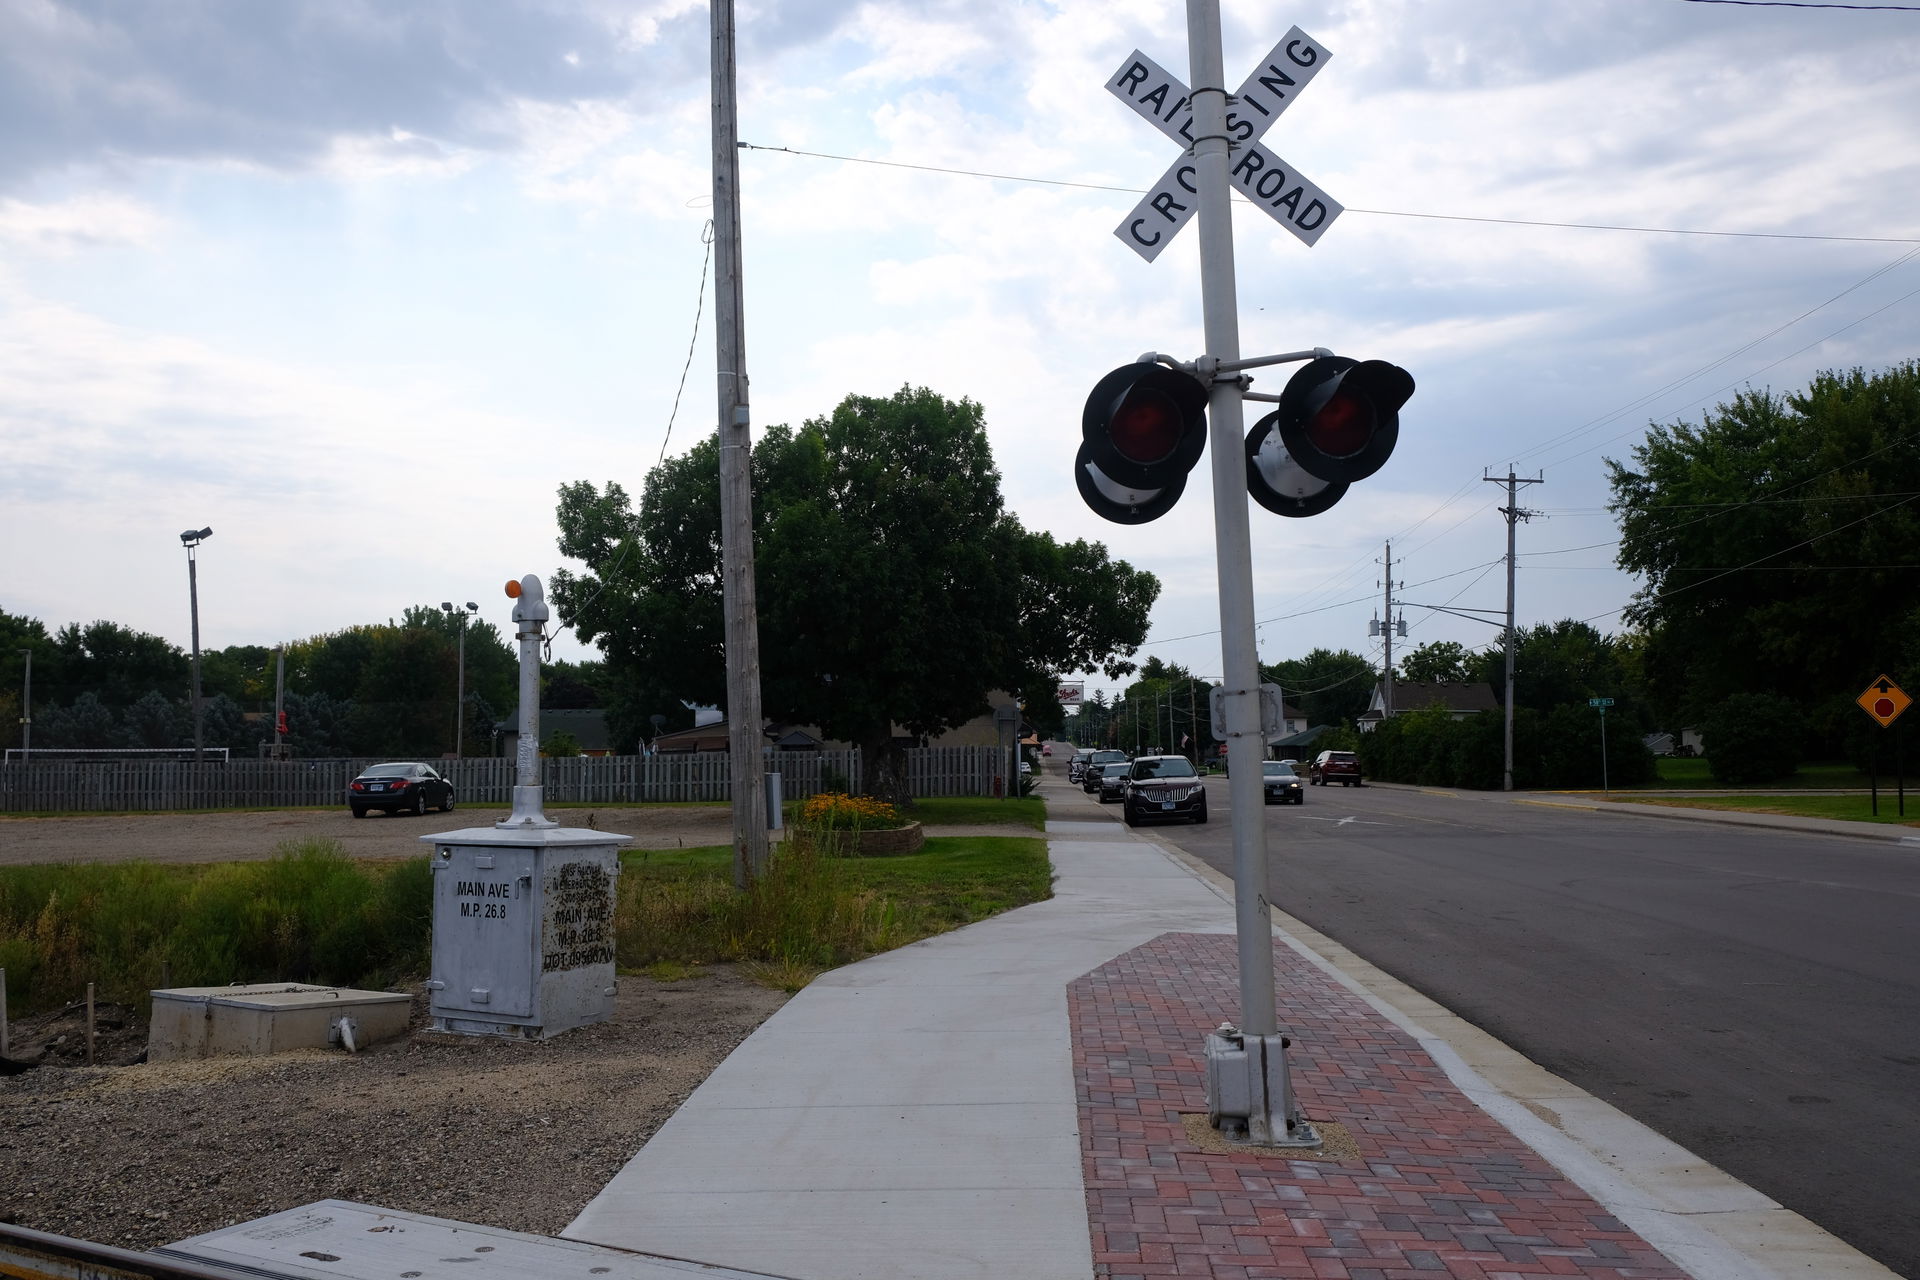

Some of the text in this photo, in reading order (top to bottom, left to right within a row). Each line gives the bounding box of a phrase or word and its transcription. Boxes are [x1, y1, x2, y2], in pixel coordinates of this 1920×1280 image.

[1231, 148, 1327, 231] ROAD
[457, 881, 510, 898] MAIN AVE
[461, 902, 506, 919] M.P. 26.8
[555, 908, 582, 924] MAIN
[544, 952, 567, 969] DOT
